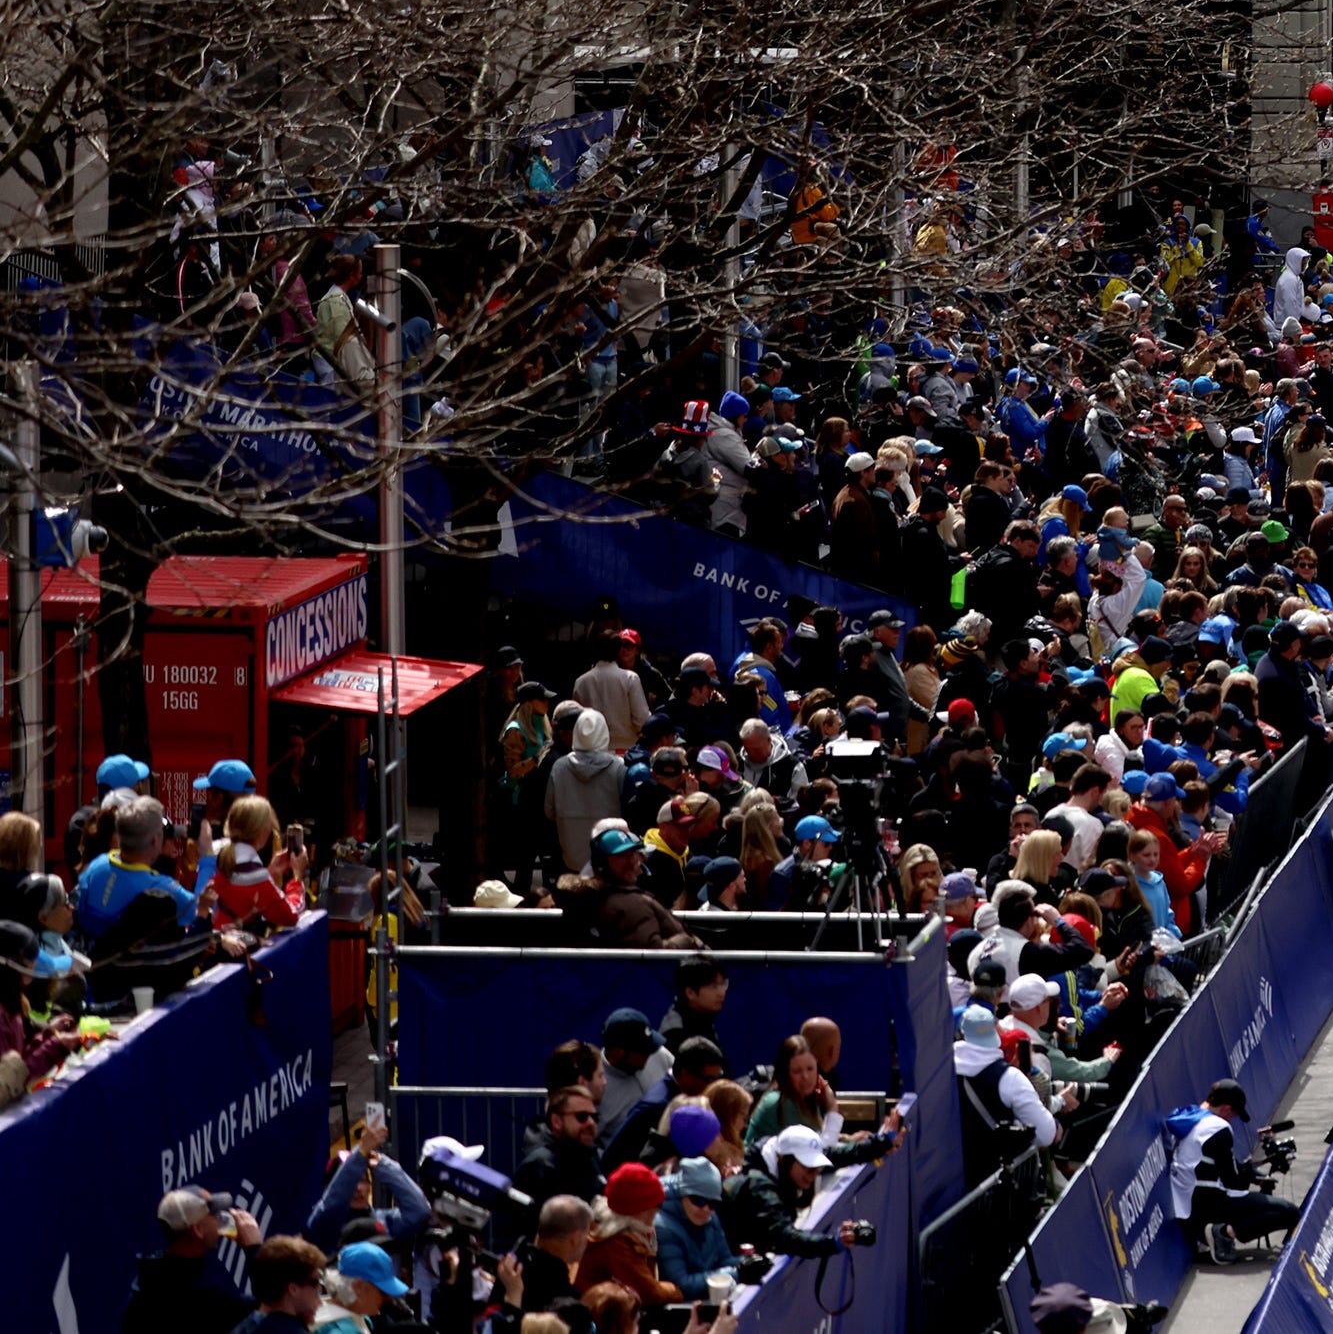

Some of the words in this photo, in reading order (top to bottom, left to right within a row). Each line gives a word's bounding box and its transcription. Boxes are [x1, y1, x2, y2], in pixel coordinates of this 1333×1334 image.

[693, 562, 750, 594] BANK
[754, 584, 781, 603] OF
[266, 576, 368, 686] CONCESSIONS
[162, 665, 218, 685] 180032
[160, 1119, 215, 1194] BANK
[217, 1101, 237, 1156] OF
[241, 1048, 313, 1139] AMERICA
